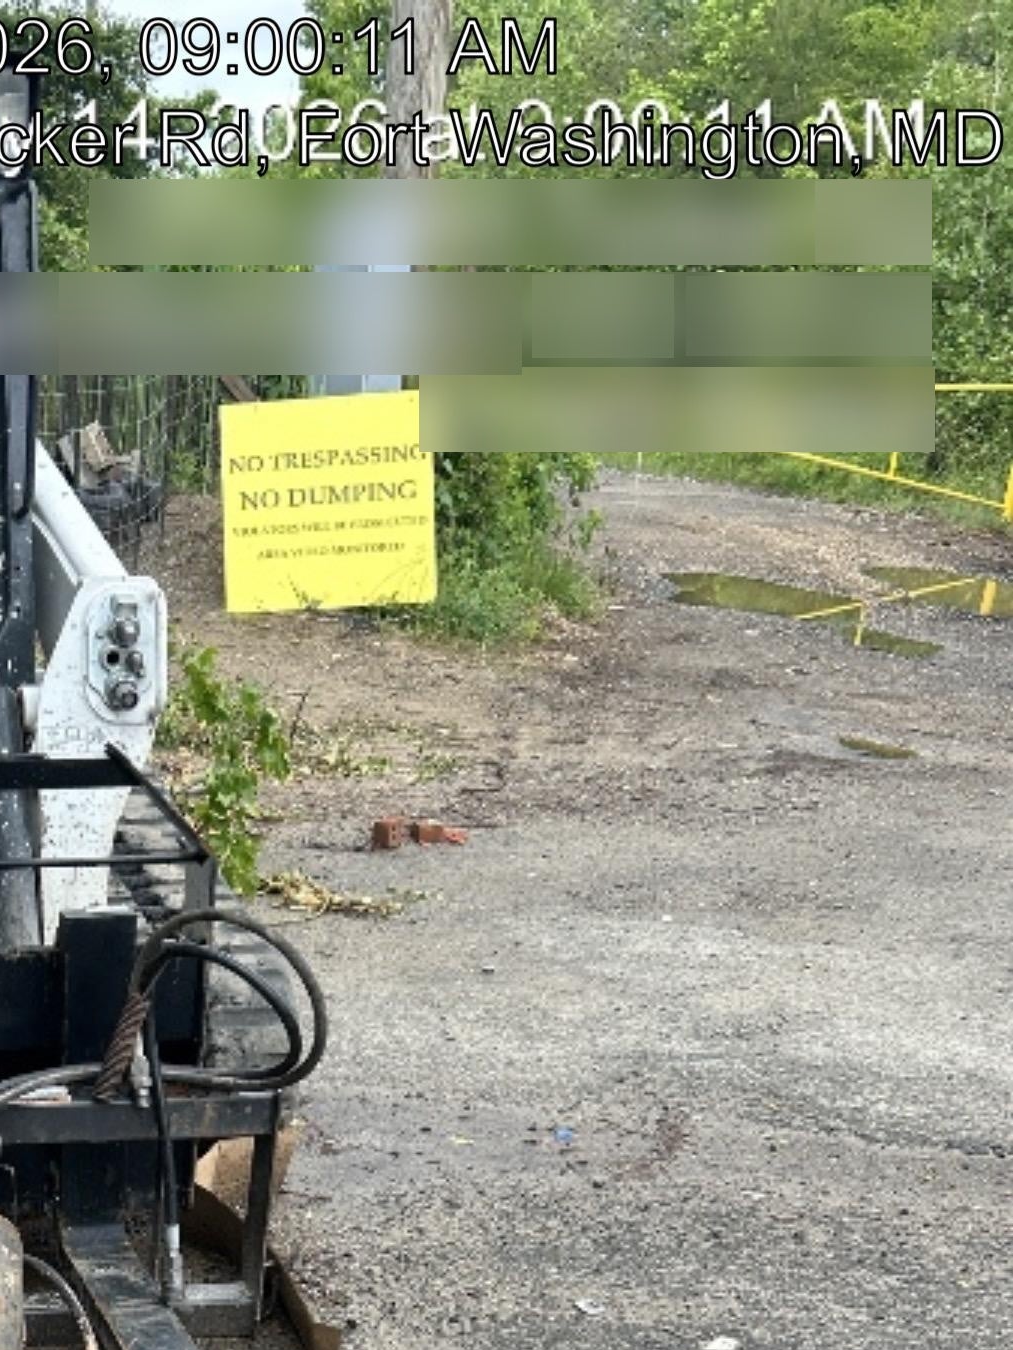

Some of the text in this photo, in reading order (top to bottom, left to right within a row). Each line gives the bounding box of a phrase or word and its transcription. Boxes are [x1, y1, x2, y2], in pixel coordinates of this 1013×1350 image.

[229, 443, 426, 474] NO TRESPASSING
[239, 479, 418, 511] NO DUMPING
